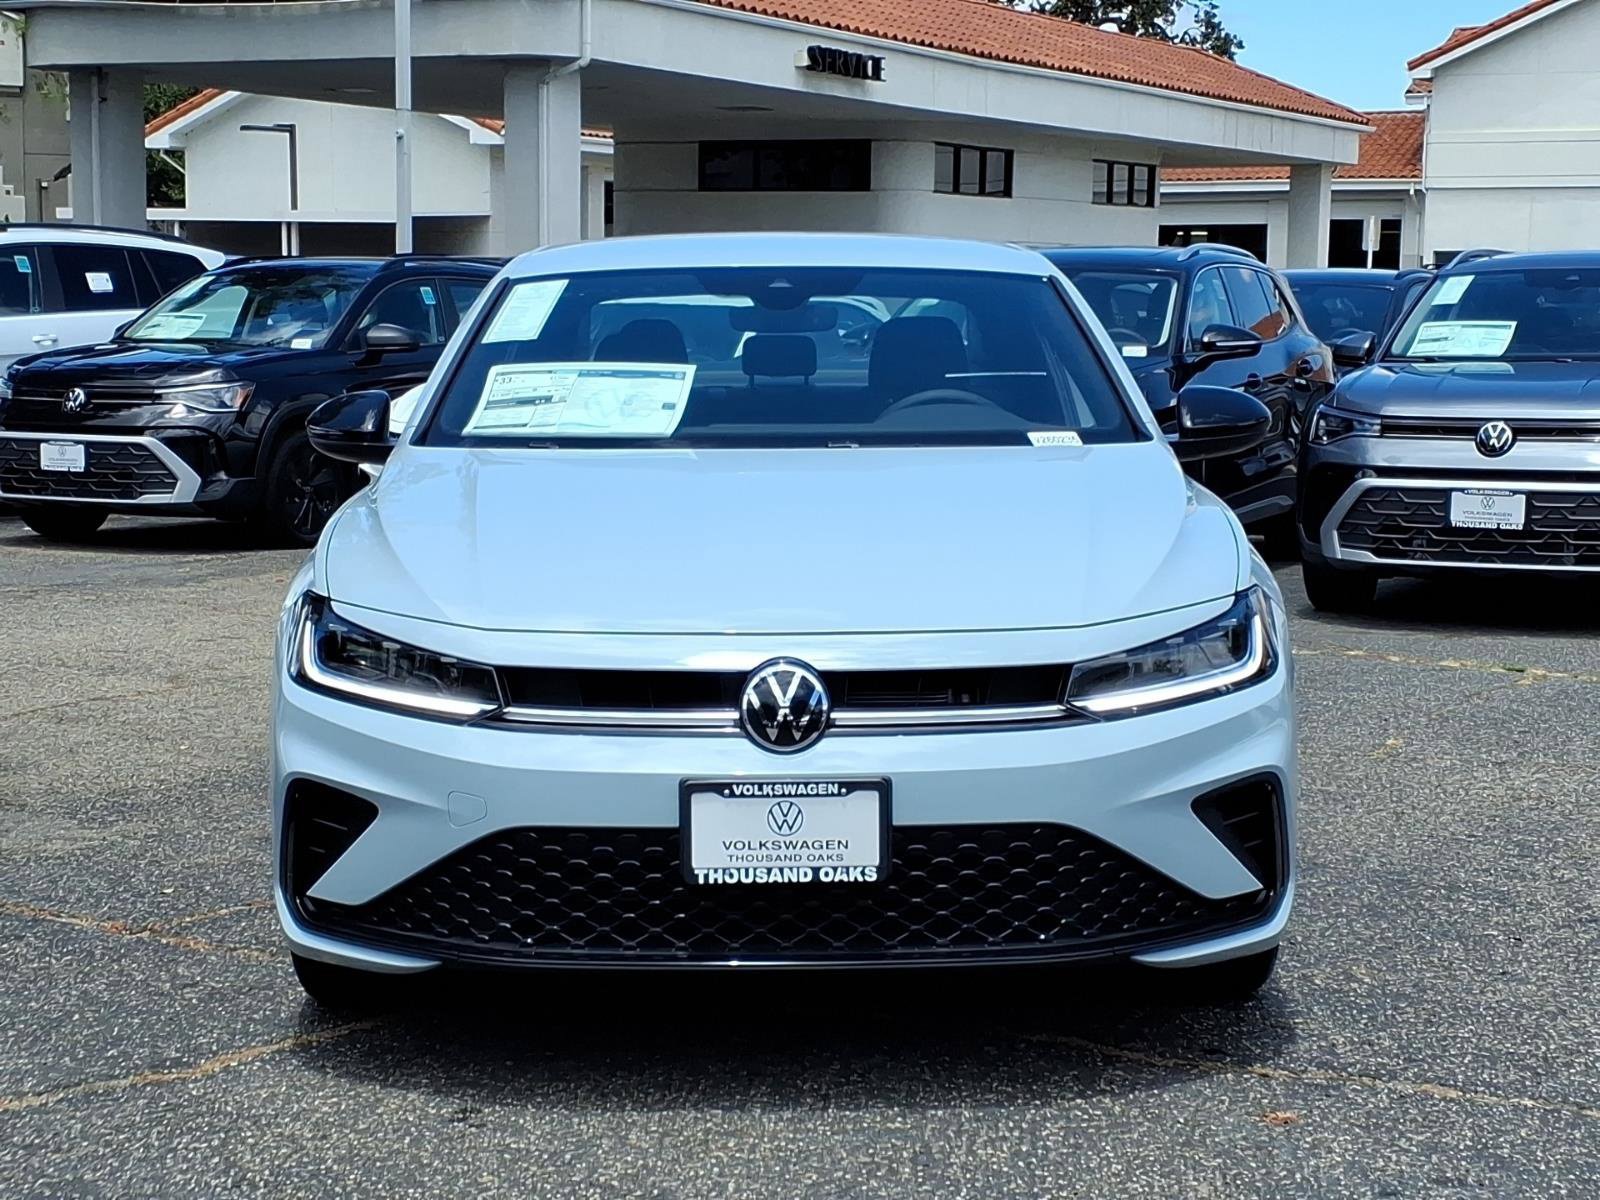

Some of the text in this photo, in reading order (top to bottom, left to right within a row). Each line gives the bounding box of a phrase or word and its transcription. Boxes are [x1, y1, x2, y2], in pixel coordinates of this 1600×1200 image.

[732, 783, 839, 796] VOLKSWAGEN
[722, 839, 849, 851] VOLKSWAGEN
[728, 853, 844, 863] THOUSAND OAKS
[694, 866, 878, 884] THOUSAND OAKS
